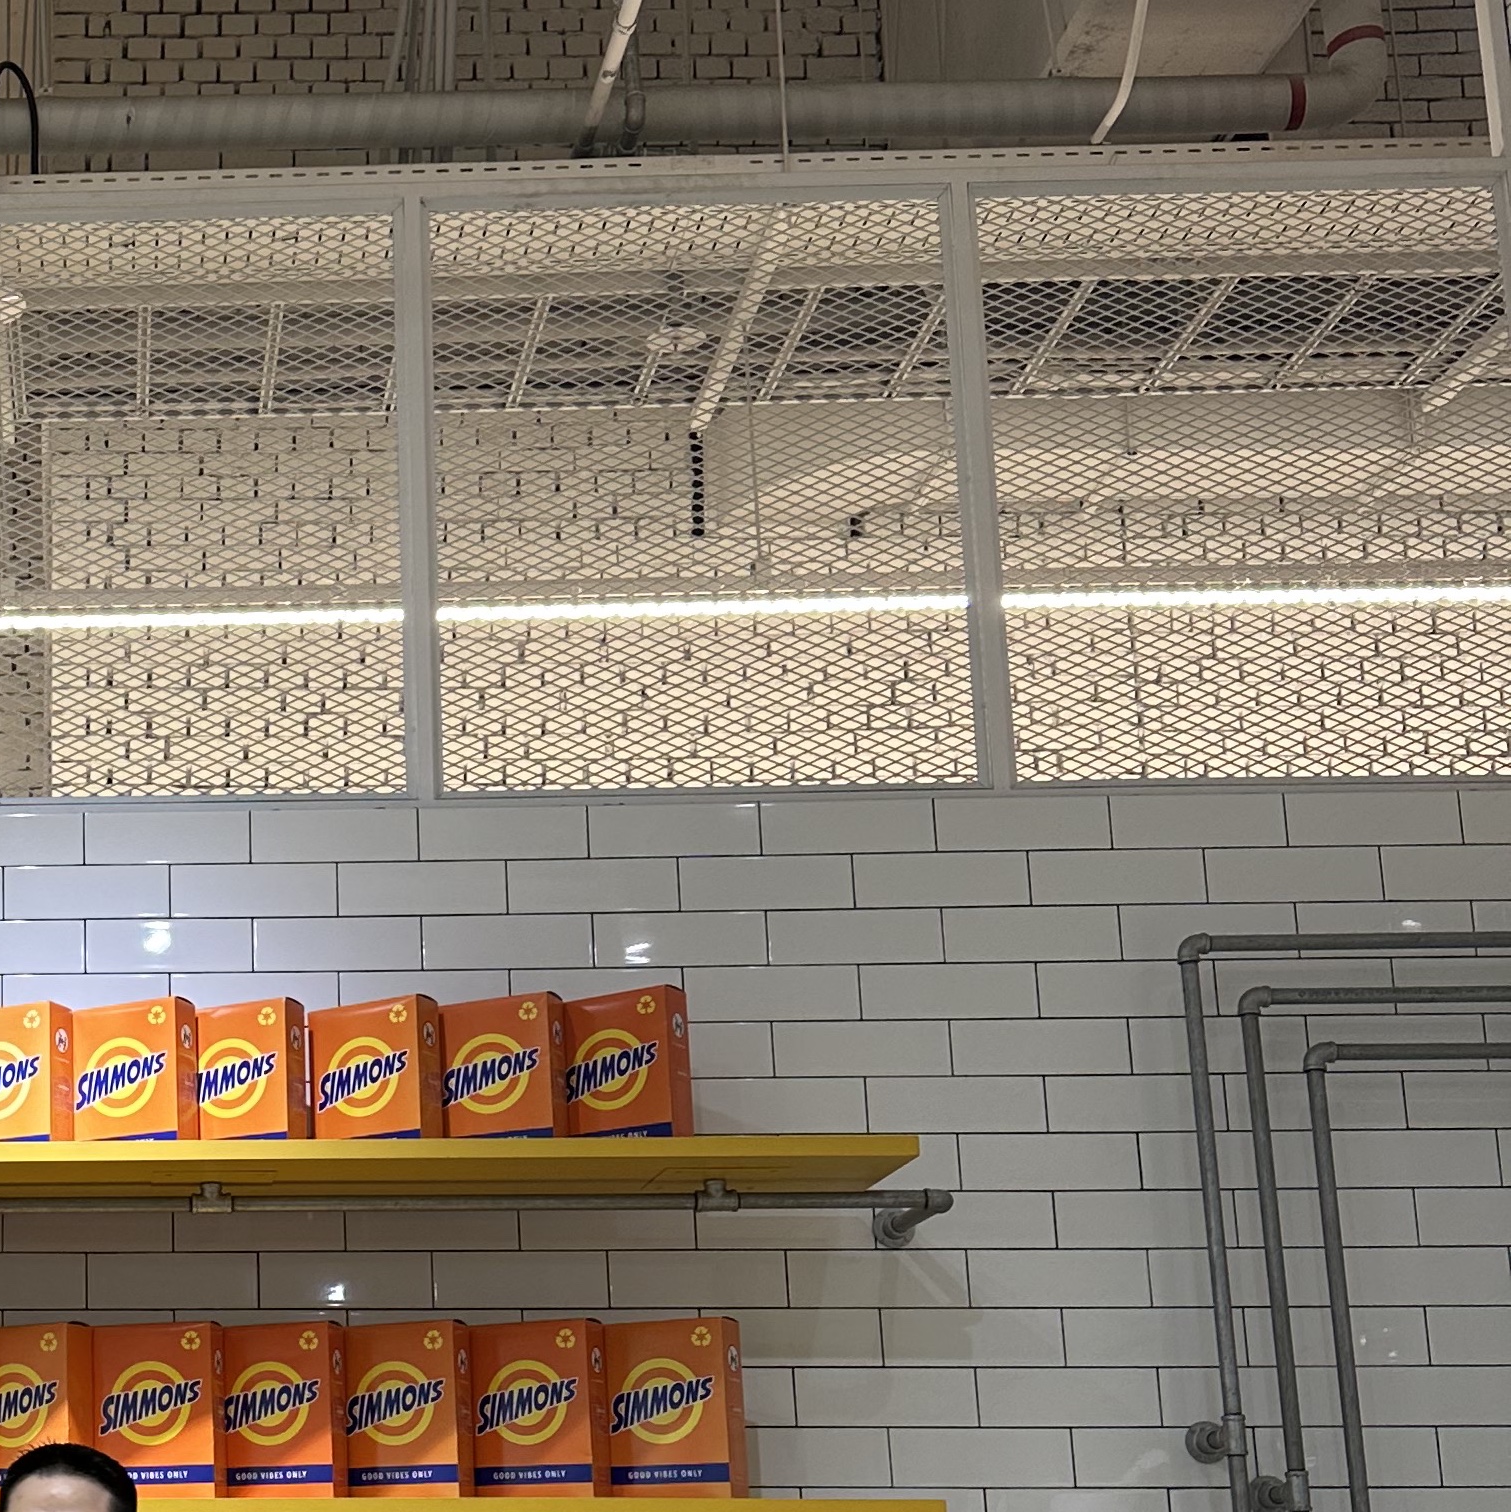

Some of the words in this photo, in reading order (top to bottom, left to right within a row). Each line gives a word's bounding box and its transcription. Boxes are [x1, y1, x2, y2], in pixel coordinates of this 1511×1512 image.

[76, 1053, 165, 1110] SIMMONS
[198, 1051, 278, 1107] IMMONS
[319, 1050, 408, 1110] SIMMONS
[442, 1046, 540, 1108] SIMMONS
[566, 1041, 658, 1105] SIMMONS
[100, 1380, 201, 1436] SIMMONS
[224, 1379, 321, 1434] SIMMONS
[346, 1378, 446, 1436] SIMMONS
[477, 1378, 578, 1435] SIMMONS
[610, 1376, 715, 1433] SIMMONS
[140, 1470, 164, 1480] VIBES
[166, 1470, 188, 1479] ONLY
[235, 1472, 258, 1481] GOOD
[260, 1471, 284, 1480] VIBES
[286, 1470, 307, 1479] ONLY
[361, 1472, 384, 1481] GOOD
[386, 1471, 409, 1480] VIBES
[411, 1470, 433, 1479] ONLY
[493, 1471, 516, 1480] GOOD
[518, 1470, 542, 1479] VIBES
[544, 1470, 566, 1478] ONLY
[628, 1471, 651, 1480] GOOD
[653, 1470, 678, 1479] VIBES
[680, 1469, 703, 1478] ONLY
